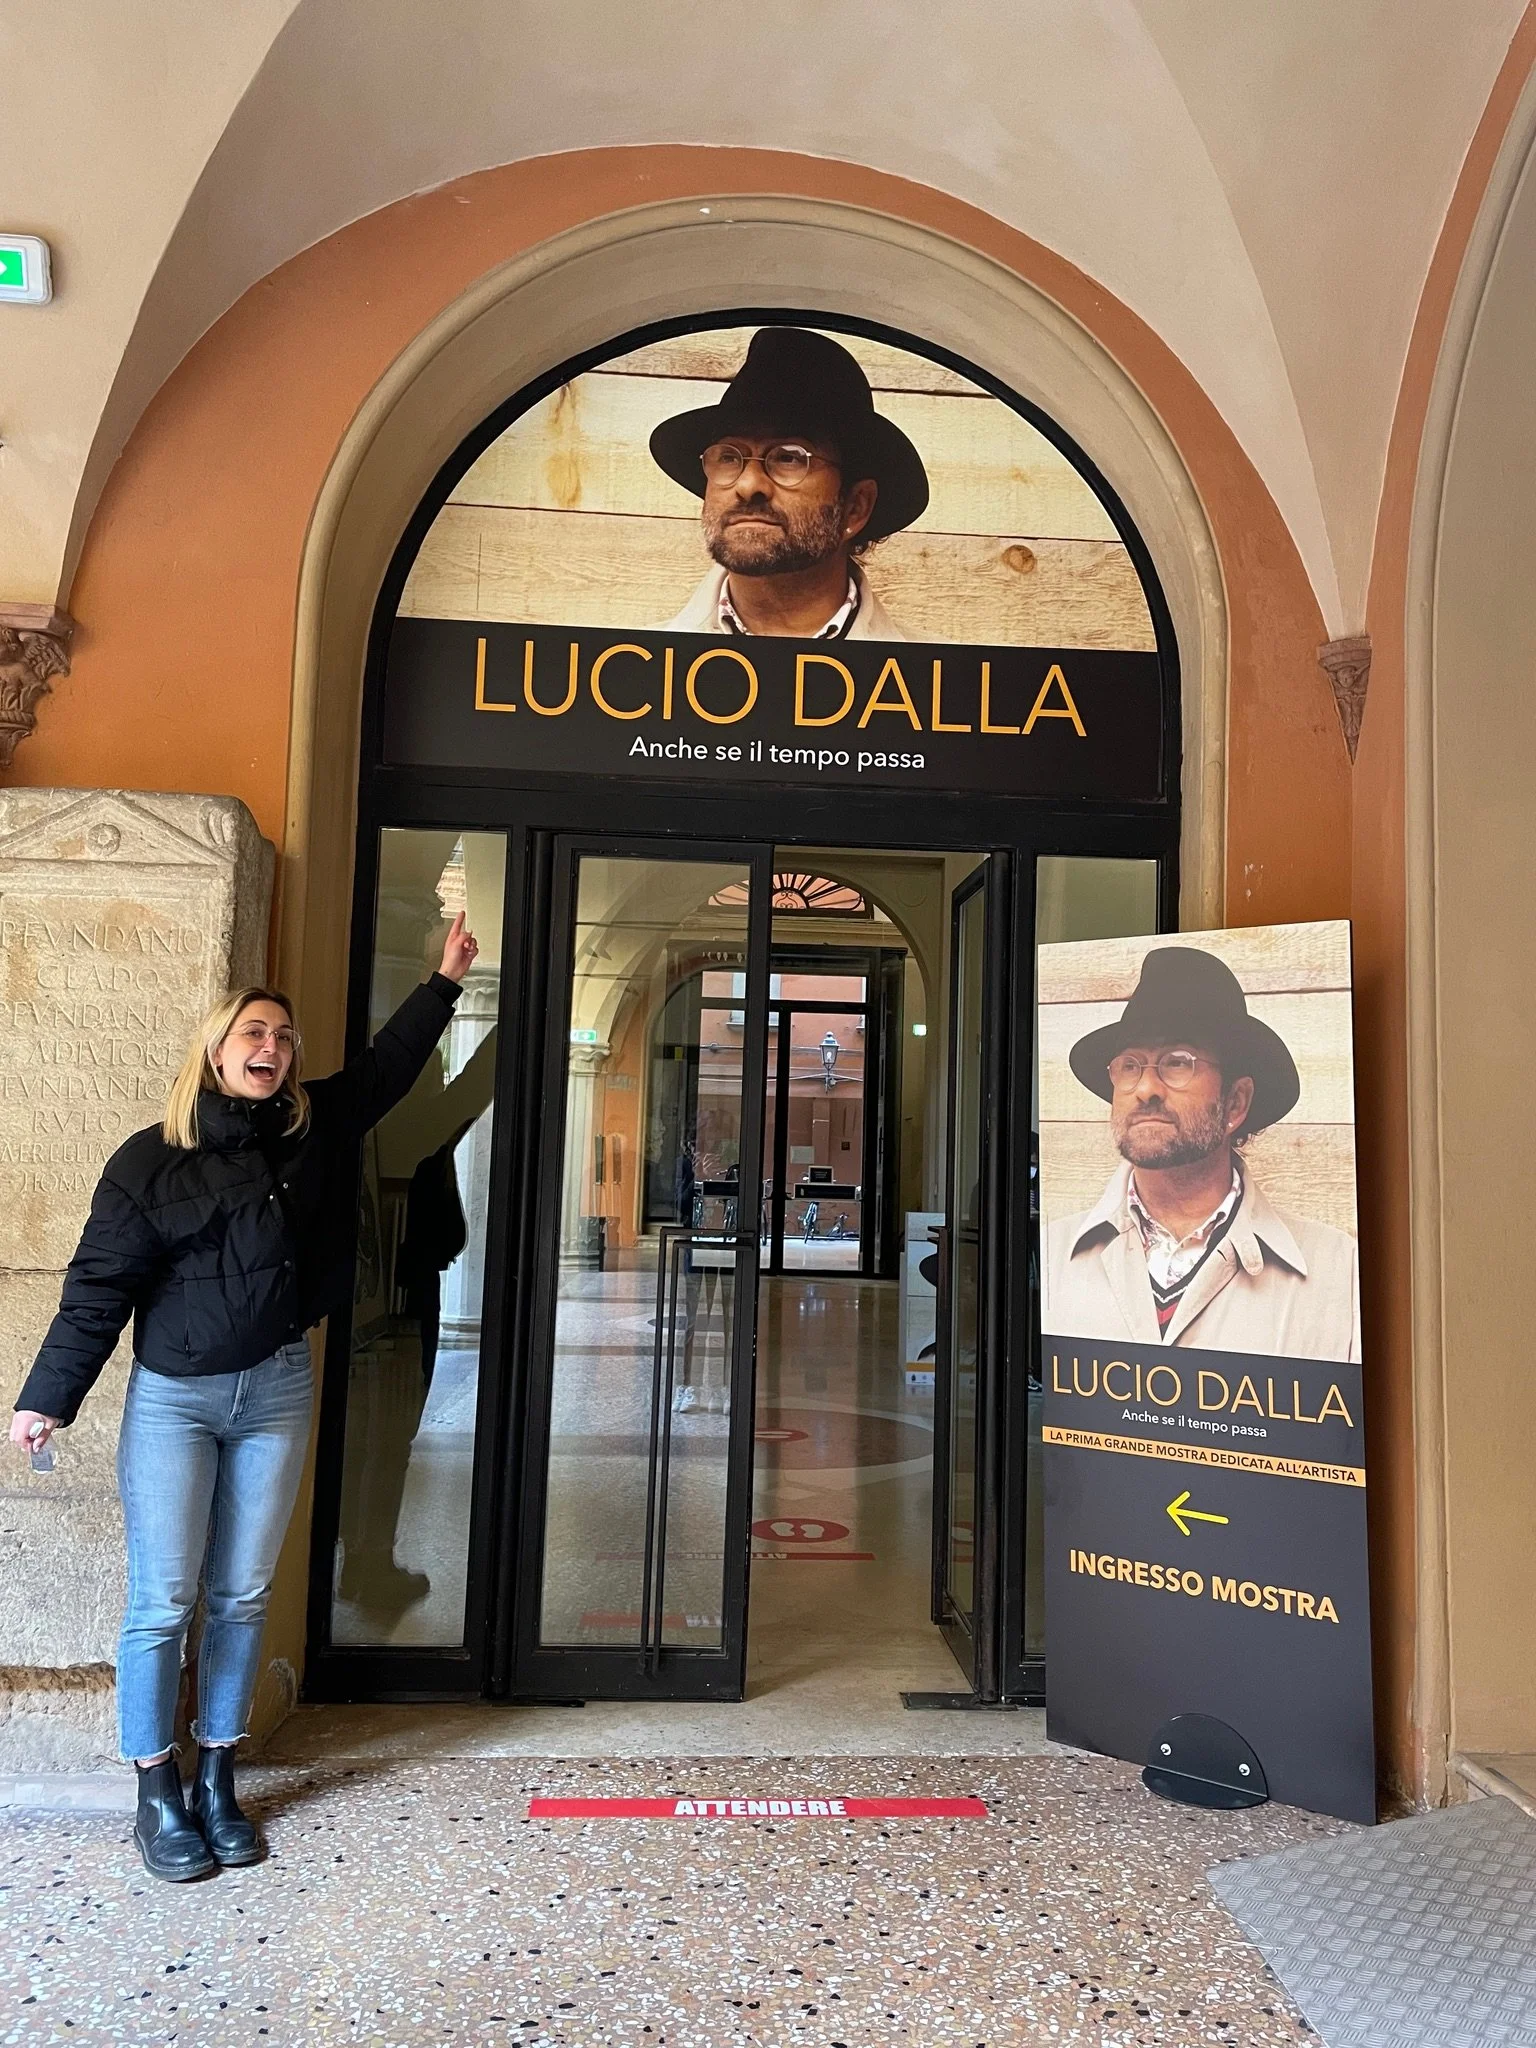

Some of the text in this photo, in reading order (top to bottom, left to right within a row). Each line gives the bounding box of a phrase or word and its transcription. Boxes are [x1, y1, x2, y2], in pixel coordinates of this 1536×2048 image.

[474, 637, 1087, 737] LUCIO DALLA
[628, 735, 925, 773] Anche se il tempo passa
[1053, 1355, 1354, 1428] LUCIO DALLA
[1121, 1408, 1268, 1438] Anche se il tempo passa
[1050, 1430, 1357, 1482] LA PRIMA GRANDE MOSTRA DEDICATA ALL'ARTISTA
[1069, 1548, 1340, 1624] INGRESSO MOSTRA
[674, 1800, 847, 1816] ATTENDERE
